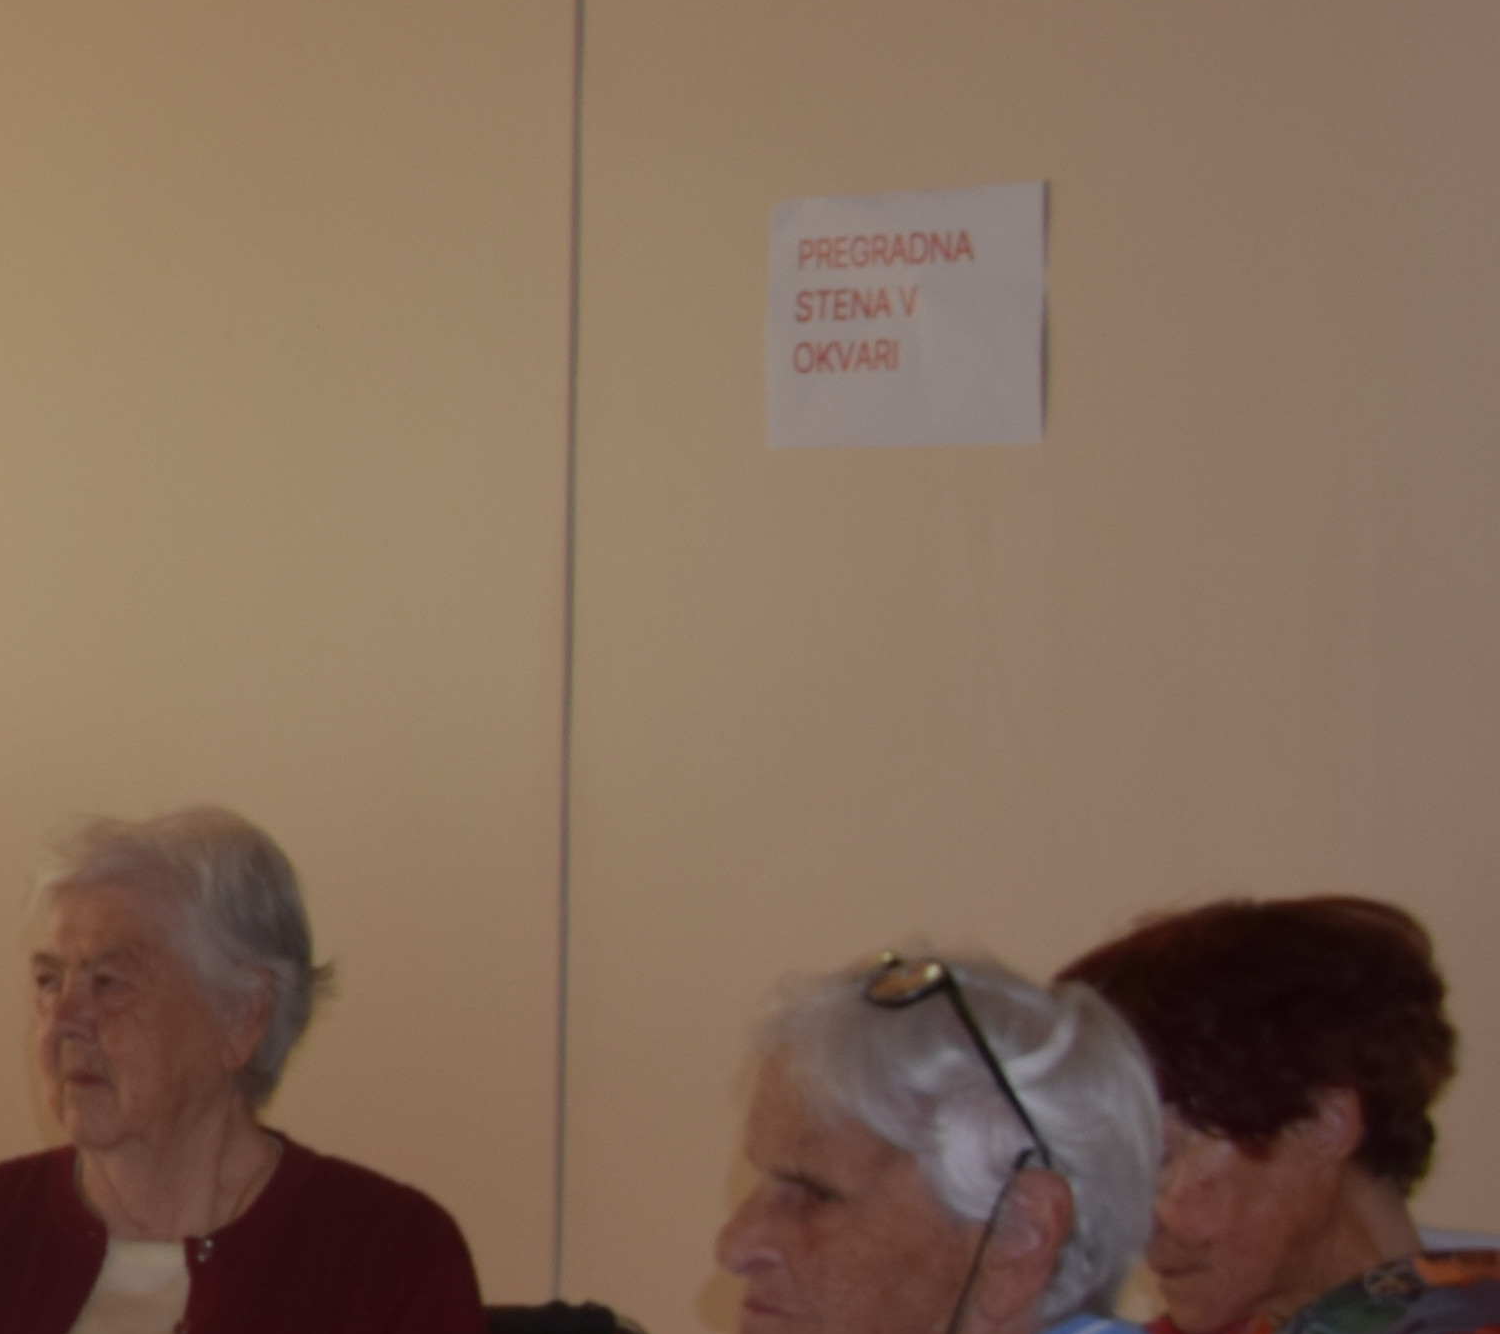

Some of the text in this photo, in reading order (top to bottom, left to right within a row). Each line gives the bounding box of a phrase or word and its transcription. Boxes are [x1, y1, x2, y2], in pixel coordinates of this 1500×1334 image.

[797, 229, 976, 270] PREGRADNA
[795, 285, 920, 323] STENA V
[792, 338, 901, 374] OKVARI
